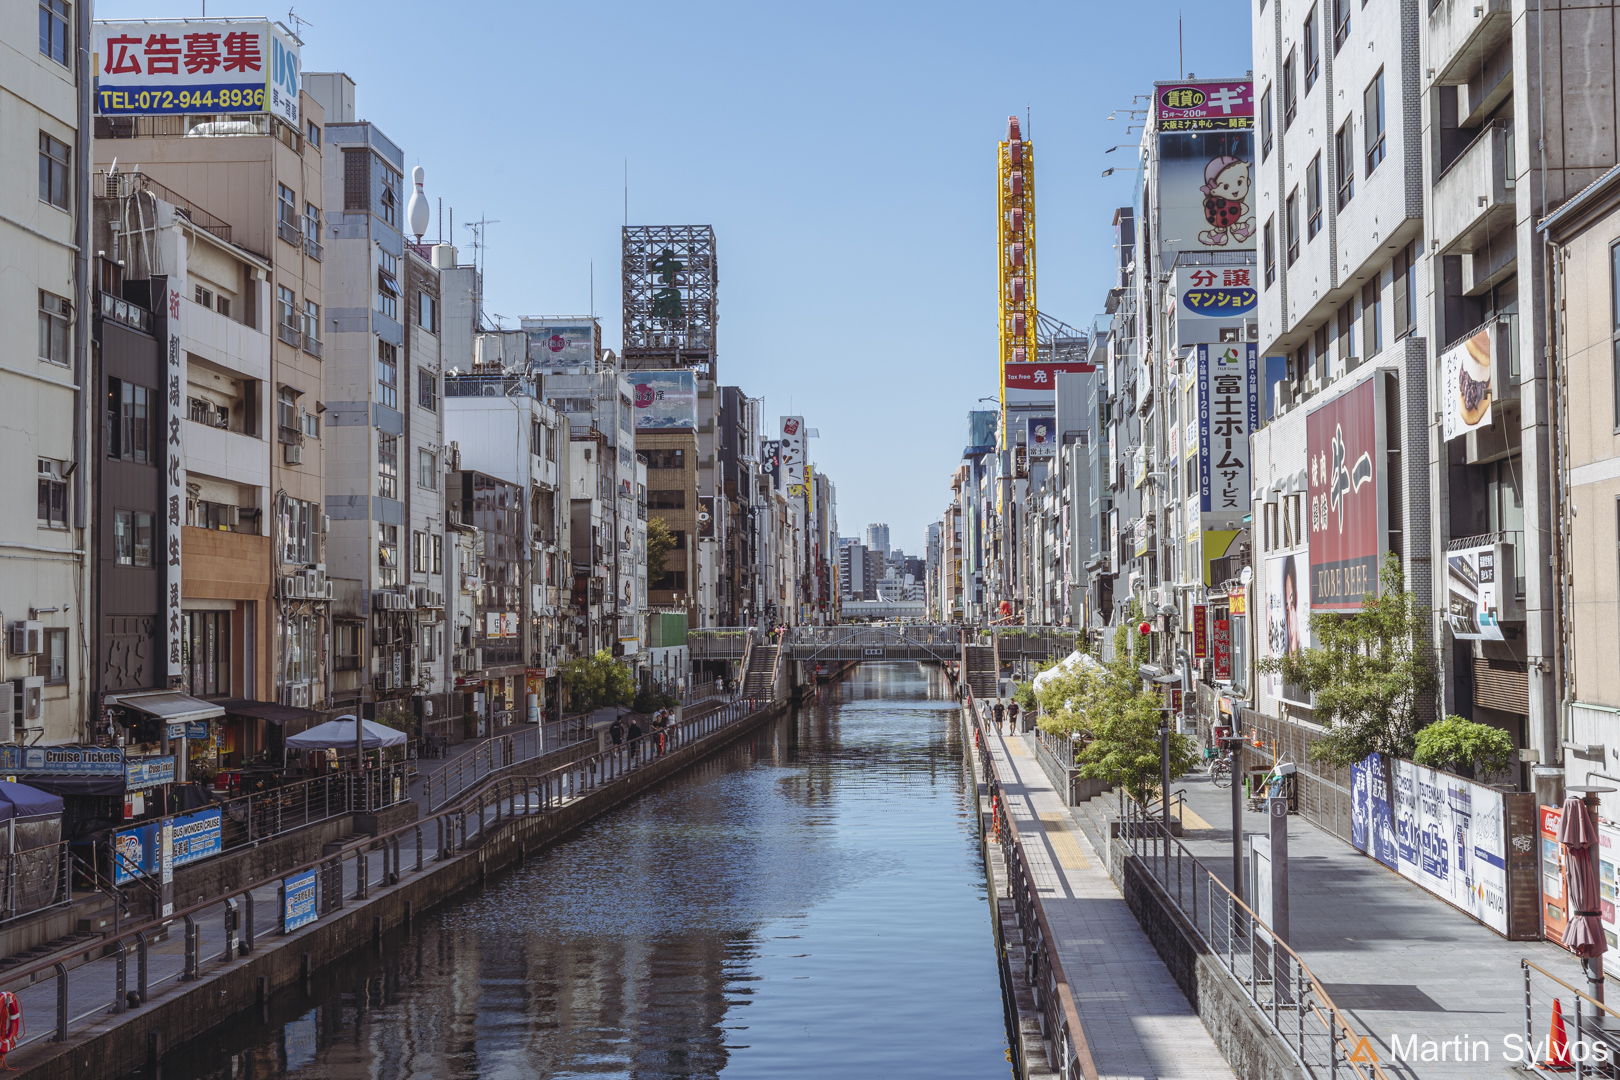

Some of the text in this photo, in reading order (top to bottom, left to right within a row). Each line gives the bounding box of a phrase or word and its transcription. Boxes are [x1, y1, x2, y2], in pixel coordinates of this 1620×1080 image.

[104, 31, 262, 76] 広告募集
[101, 88, 264, 109] TEL:072-944-8936
[1167, 85, 1254, 114] 賃貸の ギ
[652, 249, 683, 318] 千房
[1189, 268, 1251, 288] 分譲
[1188, 291, 1256, 307] マンション
[1213, 374, 1245, 508] 富士ホームサービス
[1330, 422, 1372, 534] 牛一
[1318, 564, 1368, 598] KOBE BEEF
[46, 750, 121, 763] Cruise Tickets
[1419, 781, 1447, 804] TSUTENKAKU
[184, 821, 203, 836] WONDER
[204, 816, 220, 830] CRUISE
